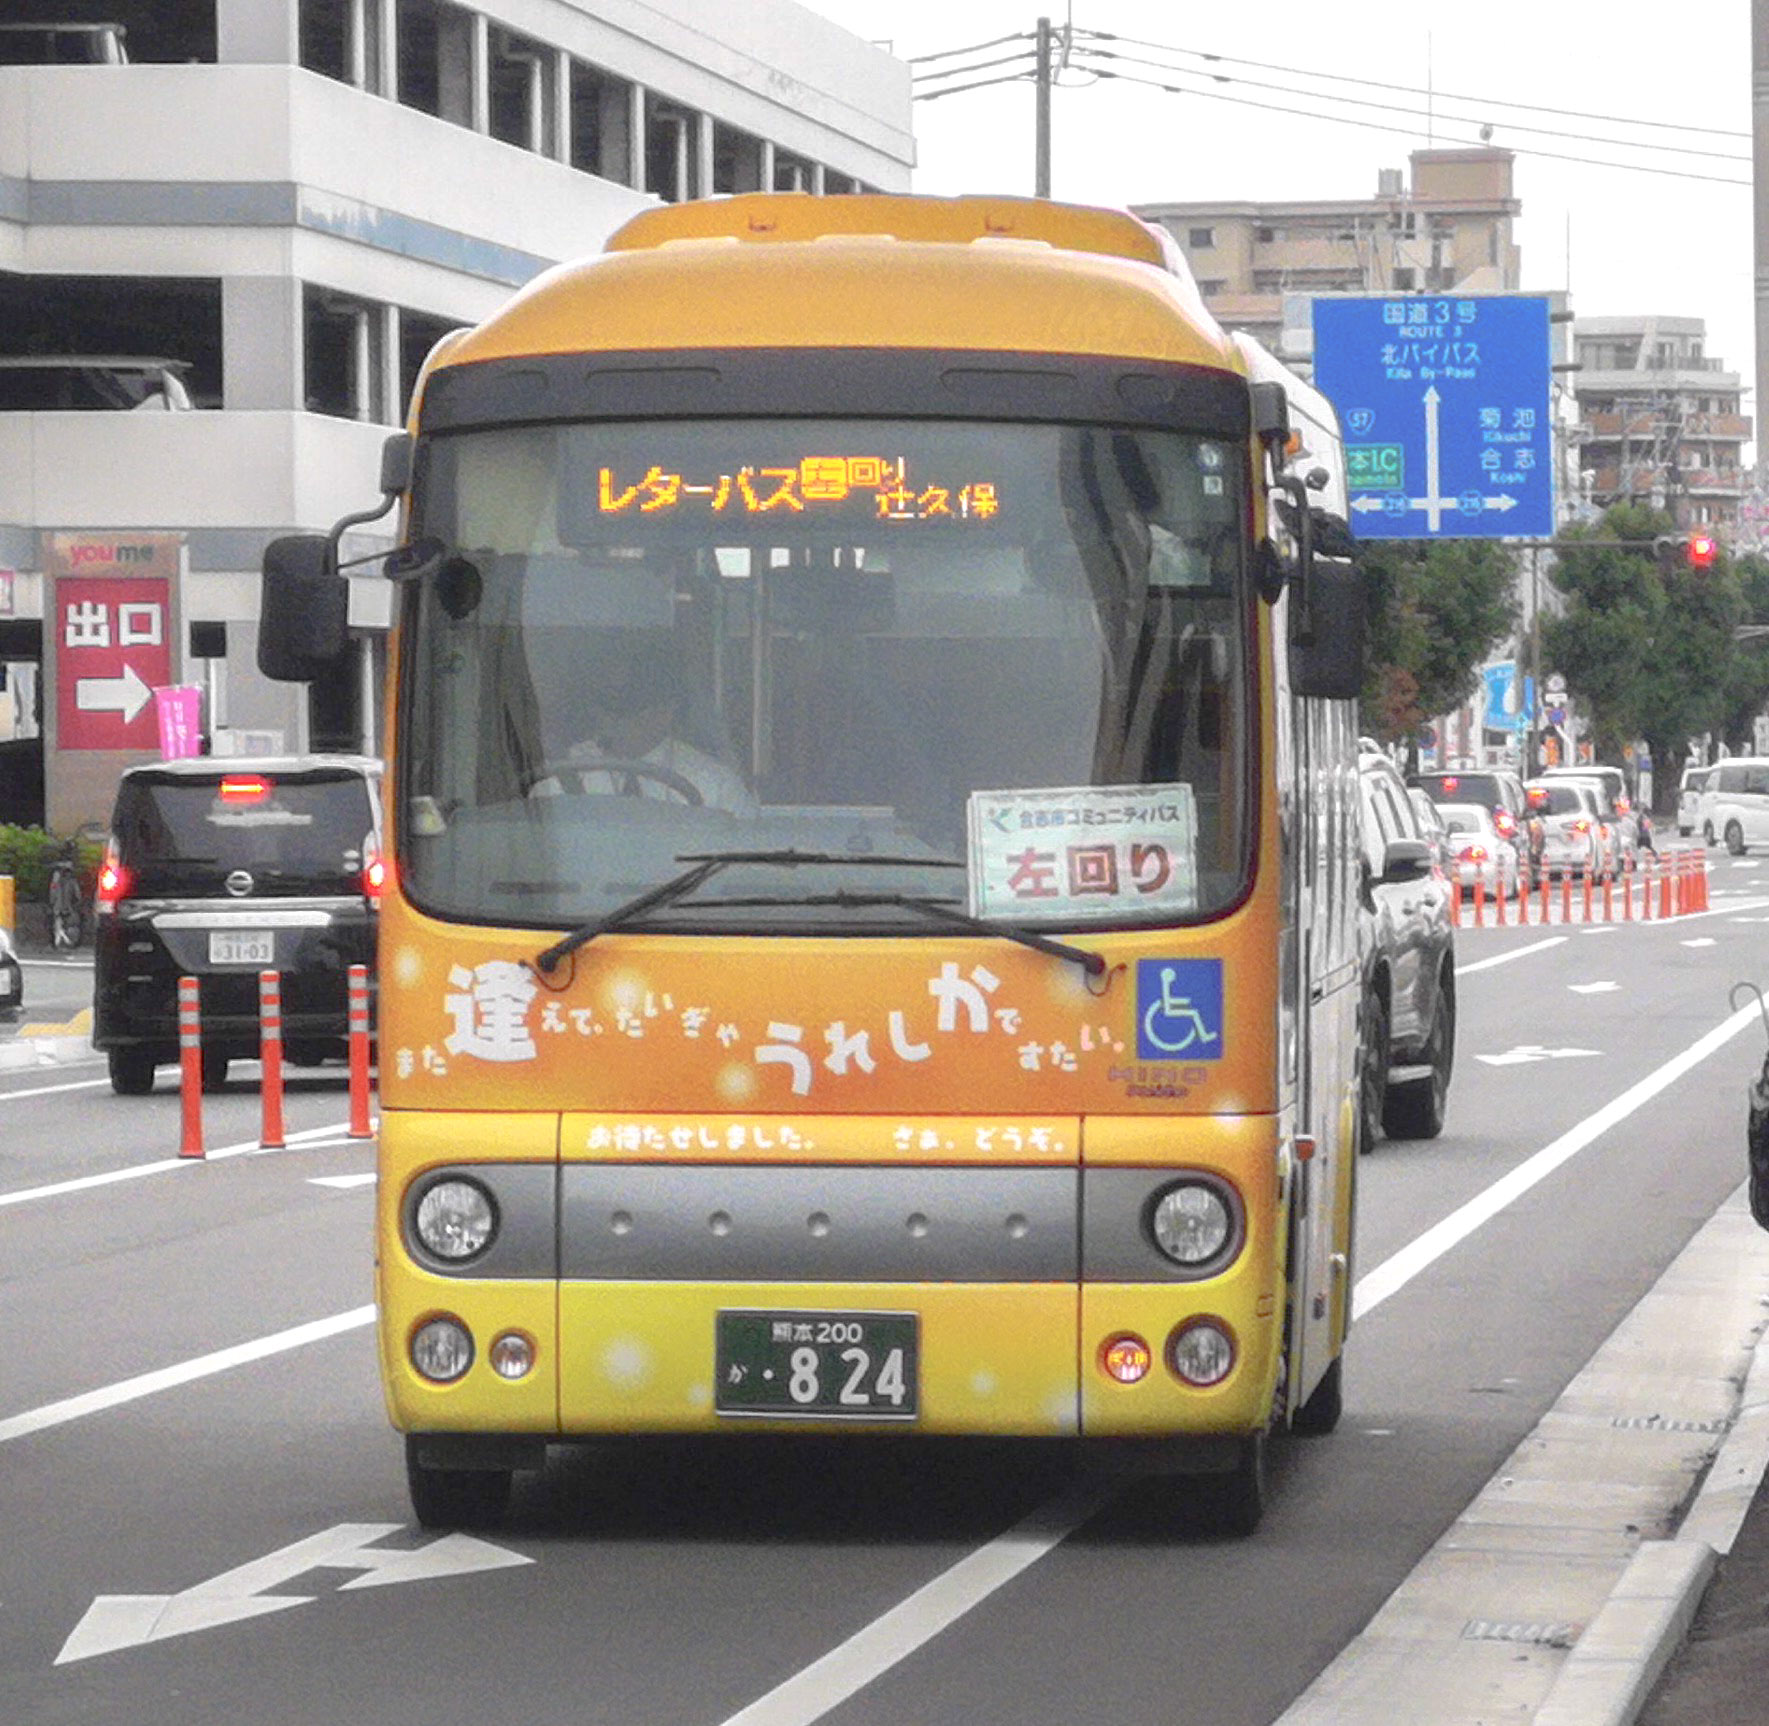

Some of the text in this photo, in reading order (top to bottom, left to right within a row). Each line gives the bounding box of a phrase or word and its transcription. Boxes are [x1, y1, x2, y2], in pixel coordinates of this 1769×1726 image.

[1380, 342, 1481, 365] 北バイパス
[71, 544, 154, 568] youme
[66, 600, 162, 647] 出口
[1006, 843, 1171, 898] 左回り
[772, 1322, 863, 1343] 熊本200
